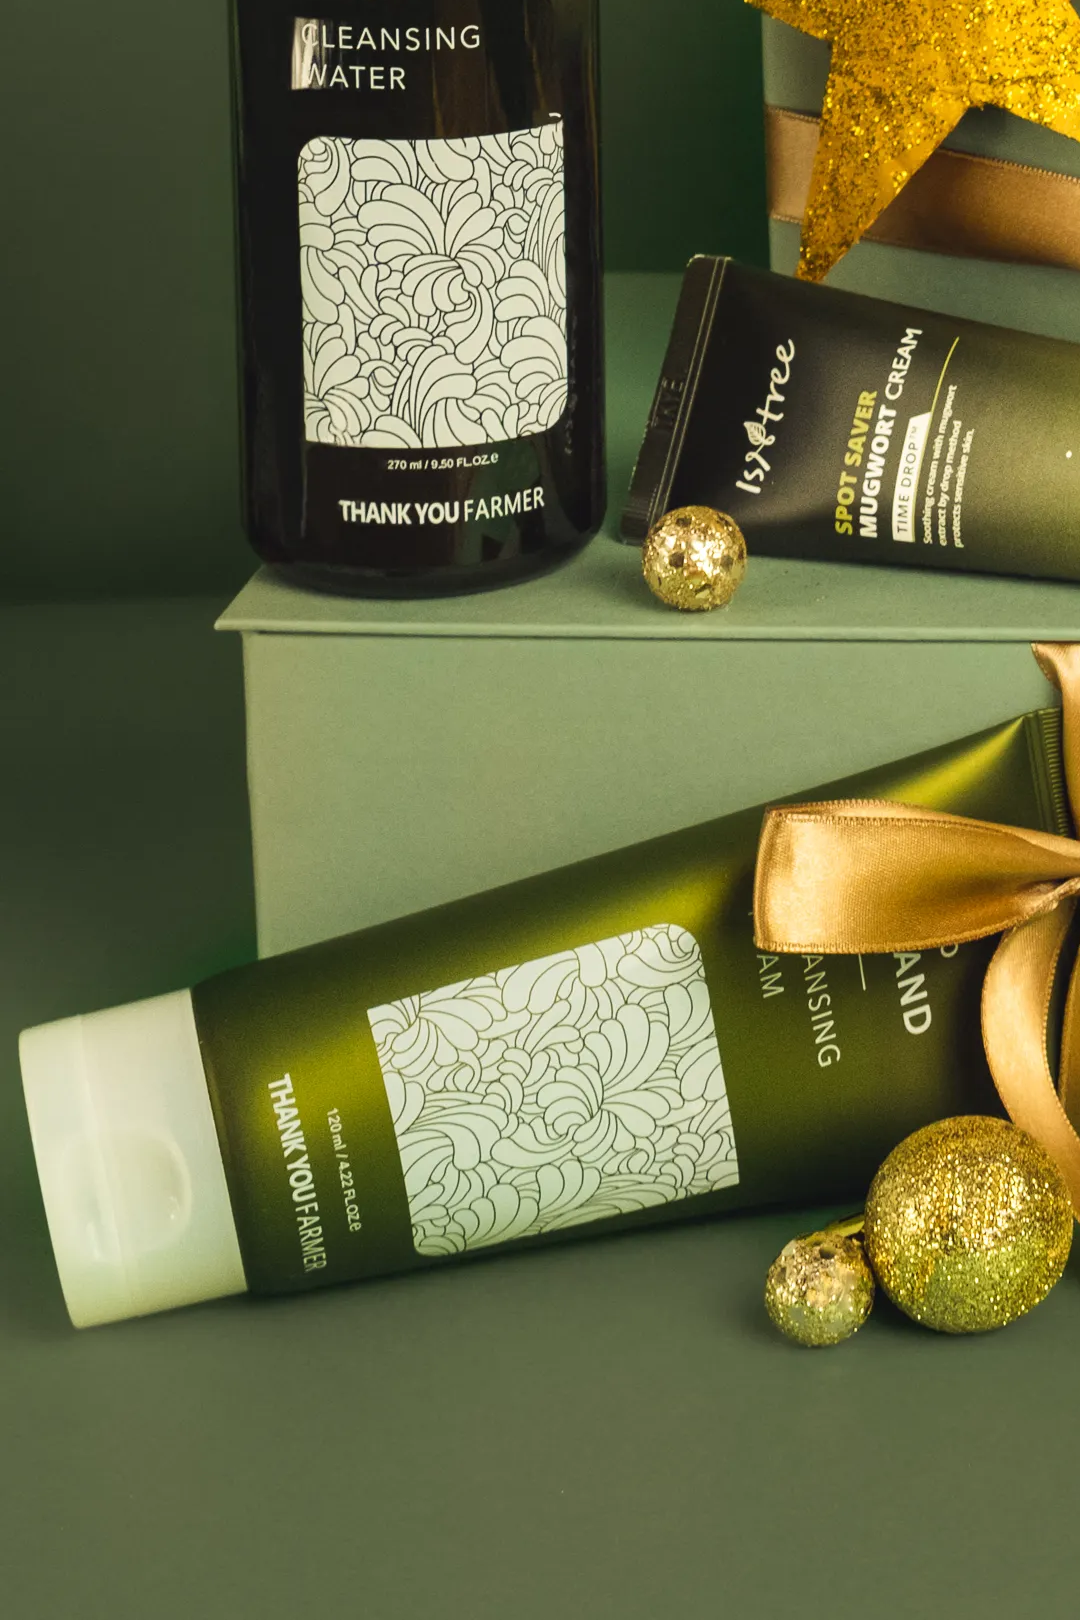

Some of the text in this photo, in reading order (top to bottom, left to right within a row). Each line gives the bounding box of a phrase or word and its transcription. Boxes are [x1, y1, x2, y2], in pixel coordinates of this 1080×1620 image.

[301, 24, 481, 51] CLEANSING
[304, 64, 406, 91] WATER
[859, 328, 923, 538] MUGWORT CREAM
[387, 460, 406, 469] 270
[410, 460, 422, 469] ml
[431, 459, 454, 469] 9.50
[835, 390, 878, 535] SPOT SAVER
[922, 385, 957, 544] Soothing cream with mugwort
[938, 420, 962, 546] extract by drop method
[955, 454, 969, 503] sensitive
[338, 486, 545, 525] THANK YOU FARMER
[896, 494, 909, 534] TIME
[953, 504, 964, 548] protects
[327, 1107, 354, 1188] 120 ml 4.22
[268, 1073, 327, 1272] THANK YOU FARMER
